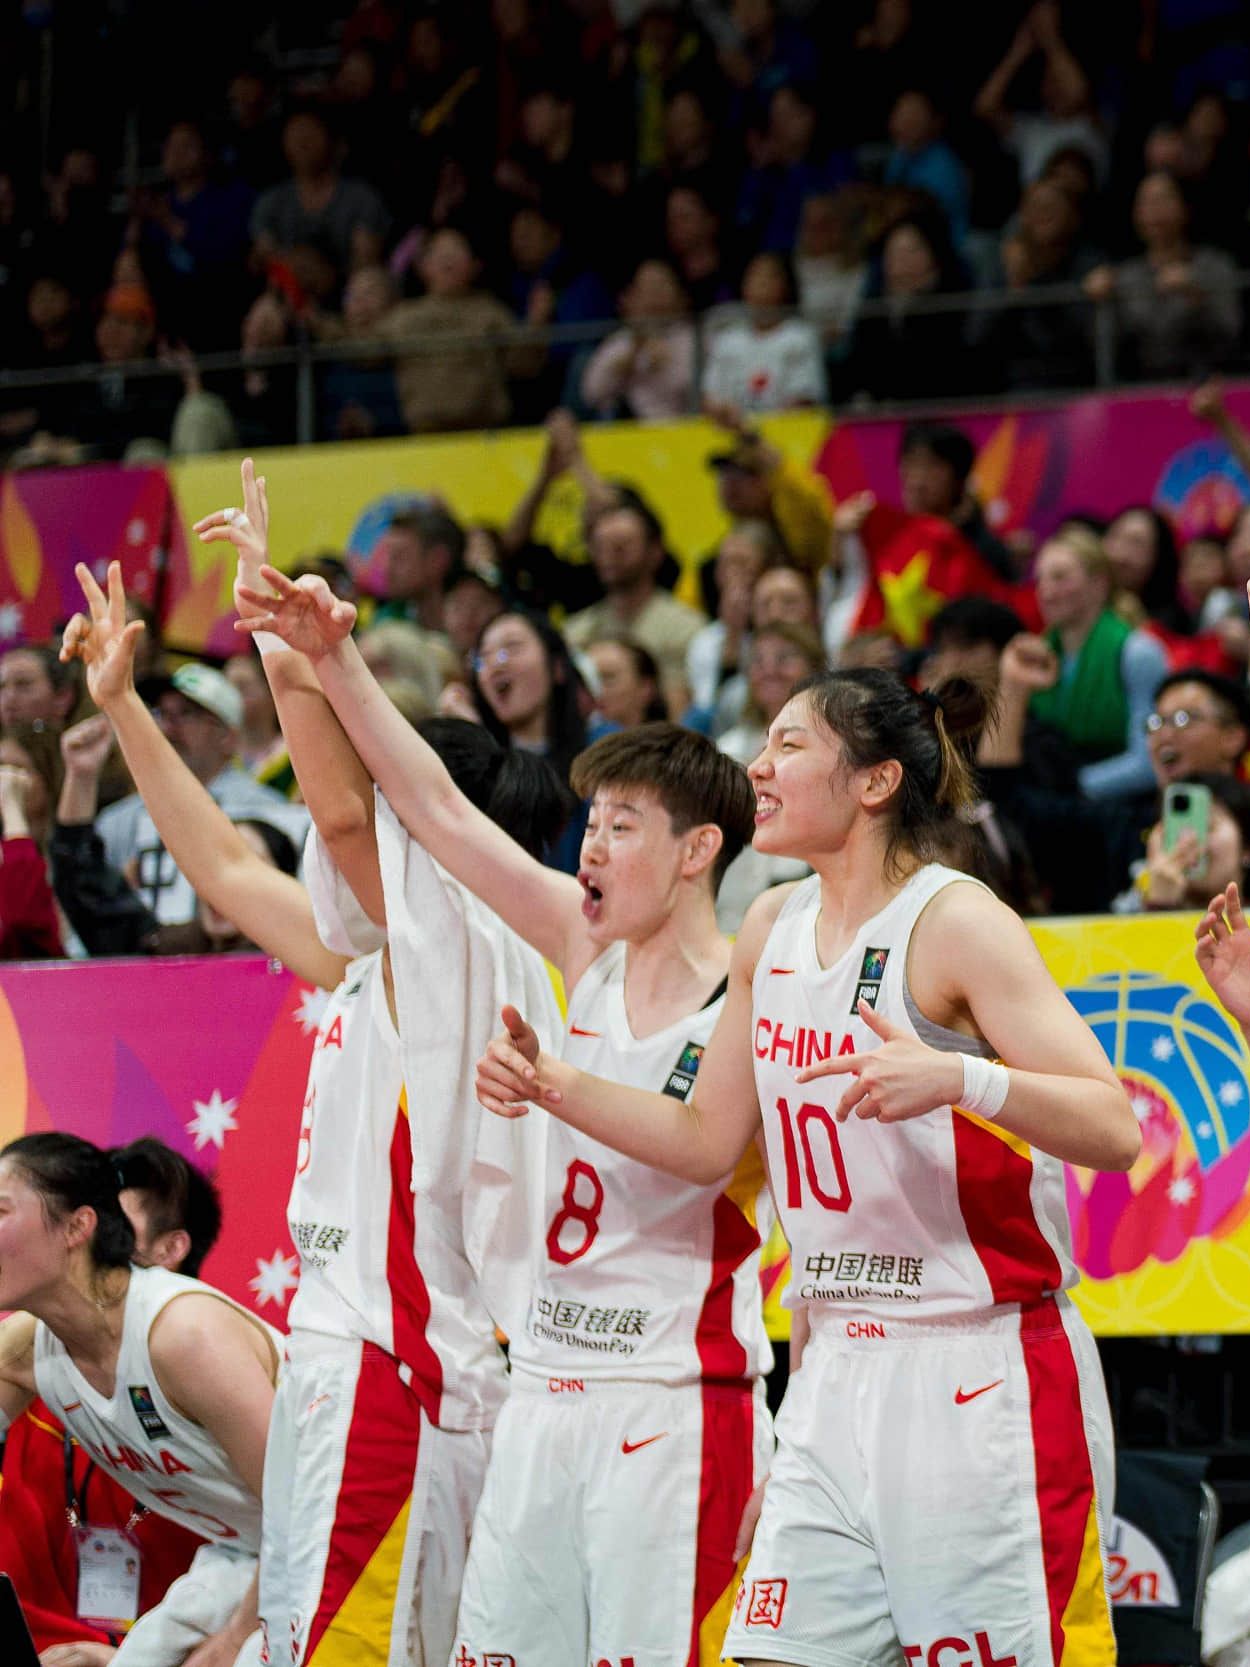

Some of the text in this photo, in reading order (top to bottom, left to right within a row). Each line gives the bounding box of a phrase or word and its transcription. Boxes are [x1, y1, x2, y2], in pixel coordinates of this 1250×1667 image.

[755, 1018, 859, 1077] CHINA
[776, 1097, 853, 1214] 10
[546, 1158, 604, 1266] 8
[804, 1252, 923, 1286] 中国银联
[800, 1284, 845, 1300] China
[537, 1297, 651, 1336] 中国银联
[846, 1321, 885, 1339] CHN
[548, 1376, 585, 1393] CHN
[93, 1440, 193, 1475] HINA
[735, 1577, 788, 1629] 国
